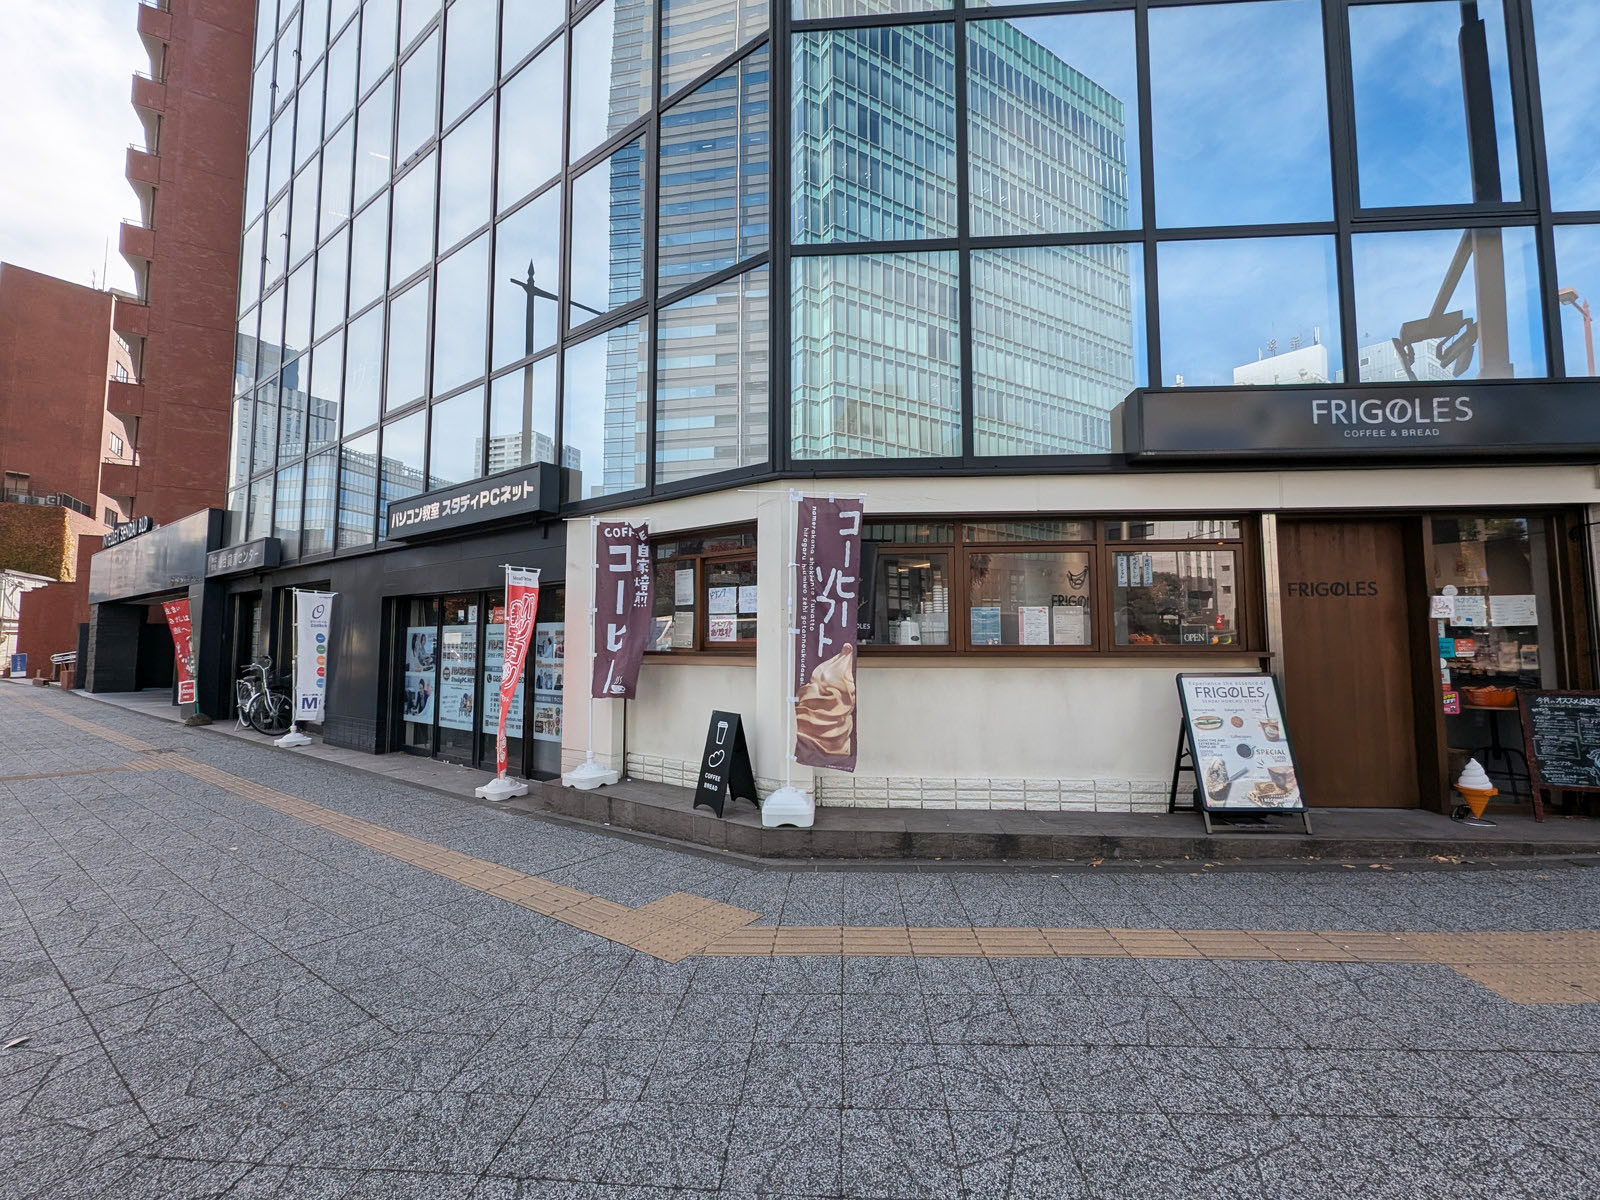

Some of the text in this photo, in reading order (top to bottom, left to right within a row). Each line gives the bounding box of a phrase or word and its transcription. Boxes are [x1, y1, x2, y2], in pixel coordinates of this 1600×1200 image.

[1312, 397, 1473, 424] FRIGOLES
[1344, 429, 1386, 438] COFFEE
[1402, 428, 1440, 437] BREAD
[391, 480, 534, 528] パソコン教室 スタディPCネット
[633, 543, 649, 607] 自家焙煎
[836, 511, 860, 627] コーヒー
[1287, 581, 1378, 597] FRIGOLES
[602, 545, 632, 694] コーヒー
[816, 566, 837, 657] ソフト
[1184, 633, 1205, 642] OPEN
[1195, 686, 1265, 698] FRIGOLES
[703, 782, 718, 792] BREAD
[704, 772, 721, 782] COFFEE
